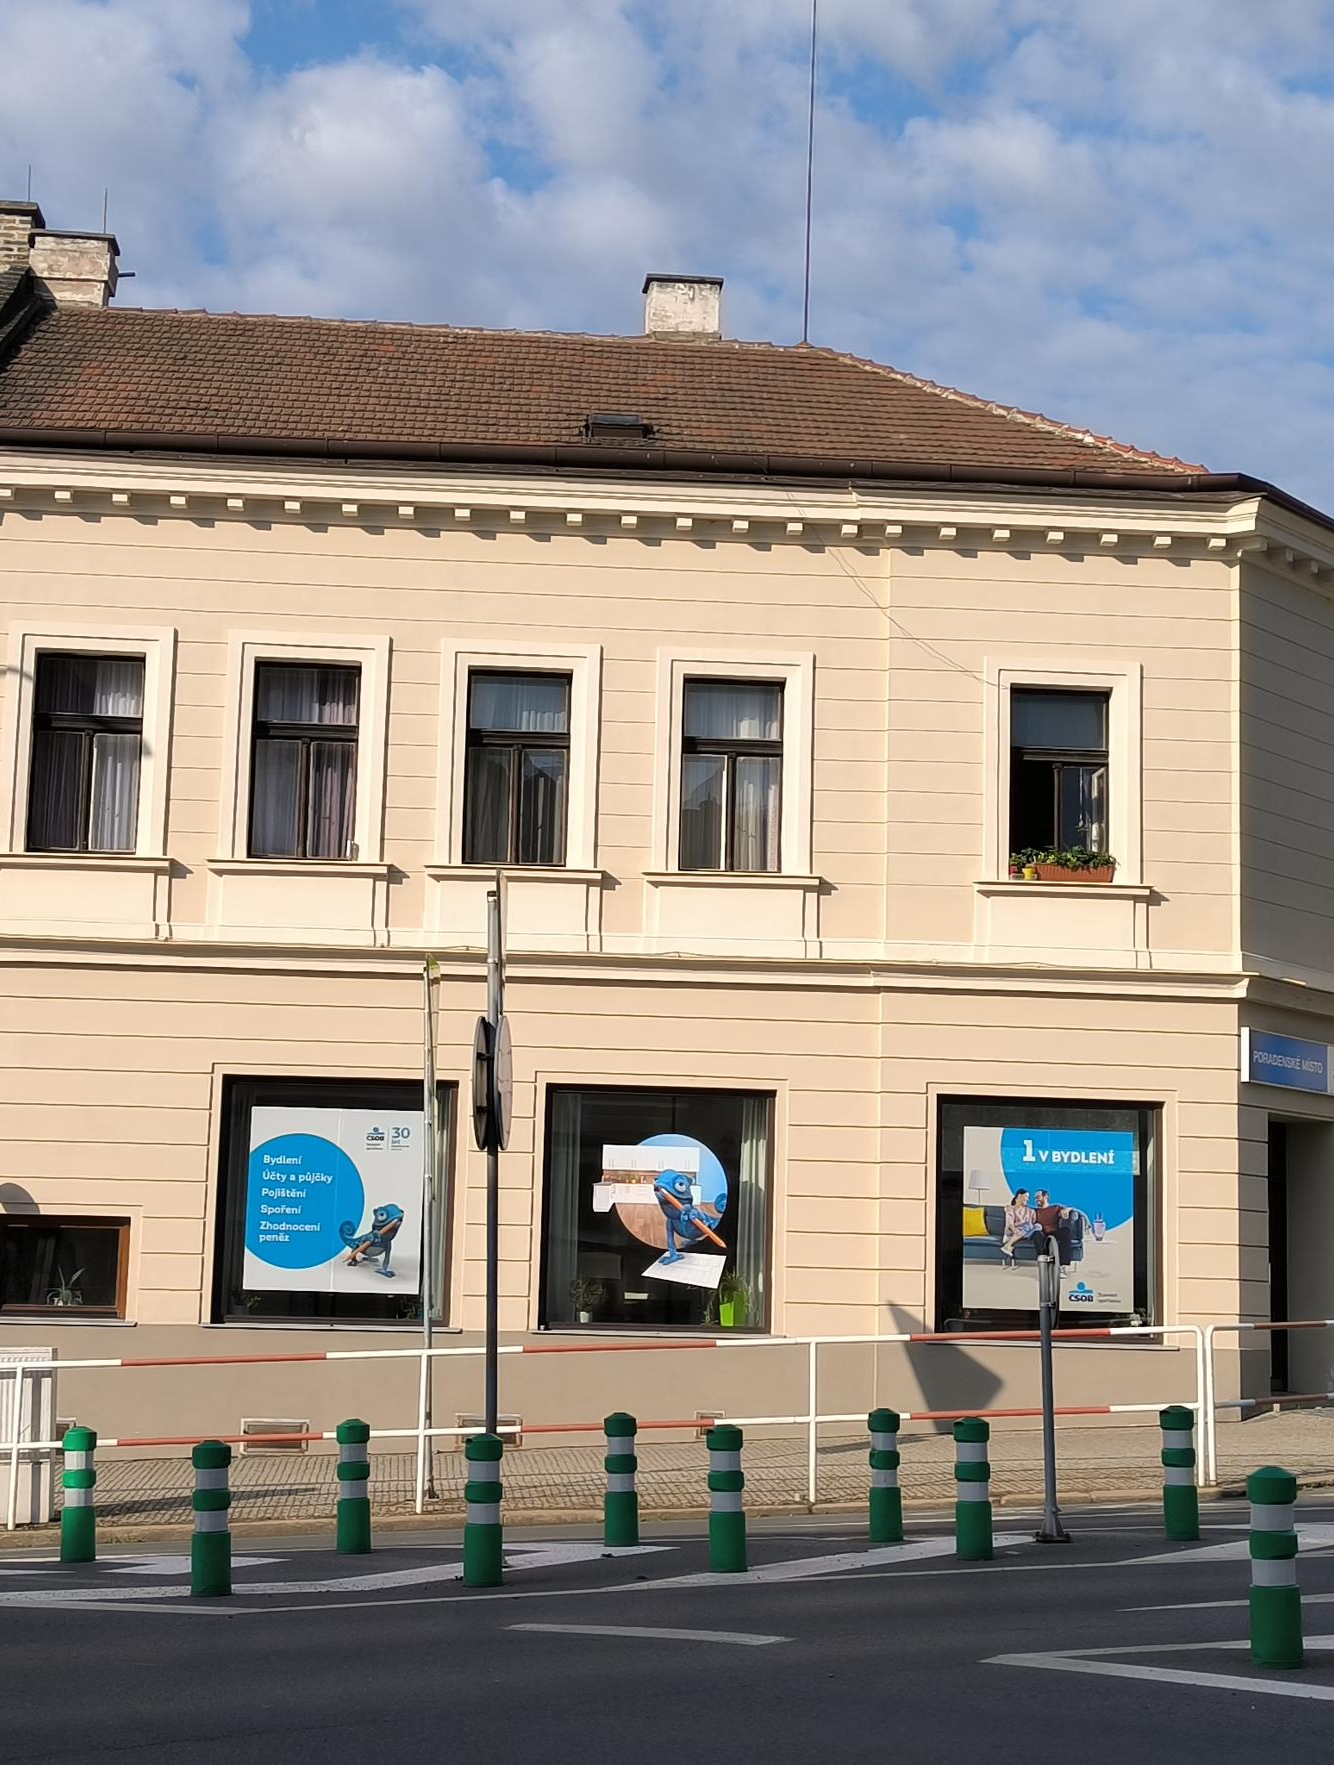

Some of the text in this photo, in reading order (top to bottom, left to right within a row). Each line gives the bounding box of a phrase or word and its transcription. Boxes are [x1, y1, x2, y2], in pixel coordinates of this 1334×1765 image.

[1302, 1057, 1323, 1074] MÍSTO
[391, 1126, 410, 1139] 30
[1022, 1139, 1115, 1165] 1 V BYDLENÍ
[263, 1154, 302, 1166] Bydlení
[262, 1169, 287, 1183] Účty
[298, 1172, 333, 1184] půjčky
[261, 1188, 307, 1199] Pojištění
[260, 1204, 302, 1215] Spoření
[259, 1221, 321, 1232] Zhodnocení
[258, 1232, 290, 1243] peněz
